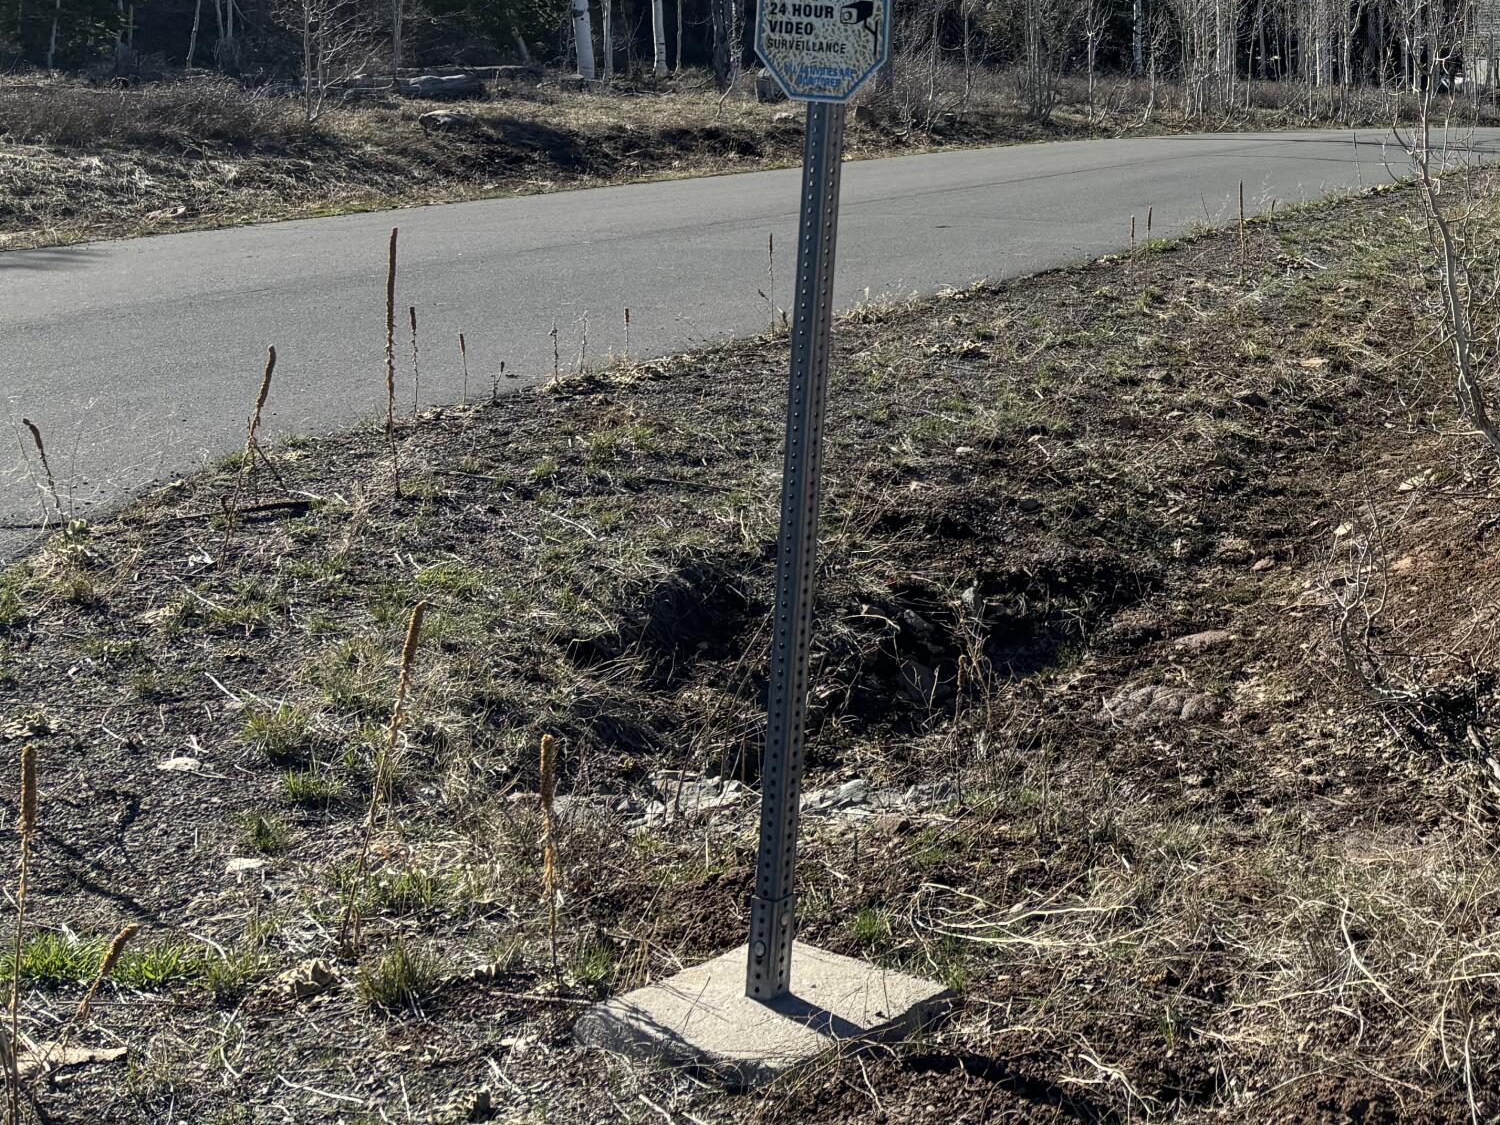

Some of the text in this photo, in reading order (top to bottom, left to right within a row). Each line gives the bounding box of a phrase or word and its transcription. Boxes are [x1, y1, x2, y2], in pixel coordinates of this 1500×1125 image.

[769, 2, 834, 19] 24 HOUR
[768, 20, 814, 35] VIDEO
[767, 38, 847, 53] SURVEILLANCE
